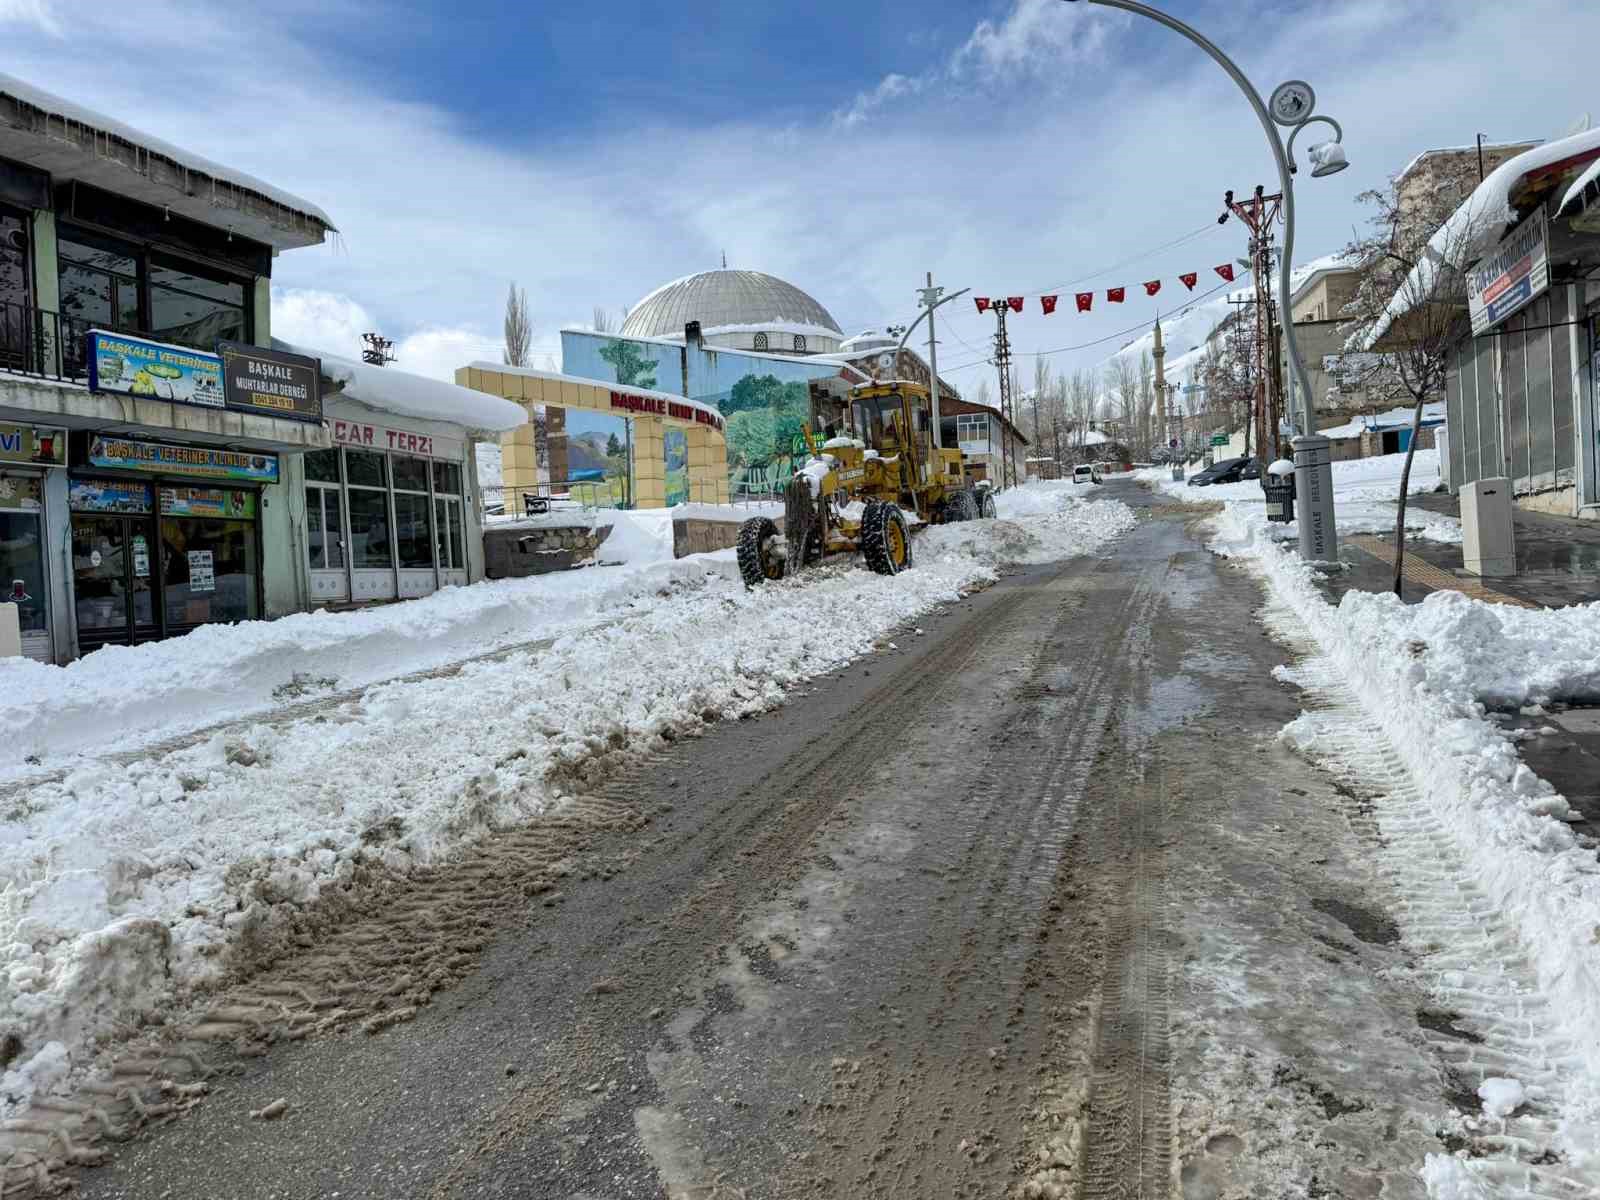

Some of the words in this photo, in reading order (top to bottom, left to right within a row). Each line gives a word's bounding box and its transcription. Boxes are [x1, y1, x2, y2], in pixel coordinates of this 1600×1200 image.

[248, 361, 292, 380] BAŞKALE
[235, 375, 278, 394] MUHTARLAR
[608, 391, 666, 414] BAŞKALE
[335, 421, 374, 445] CAR
